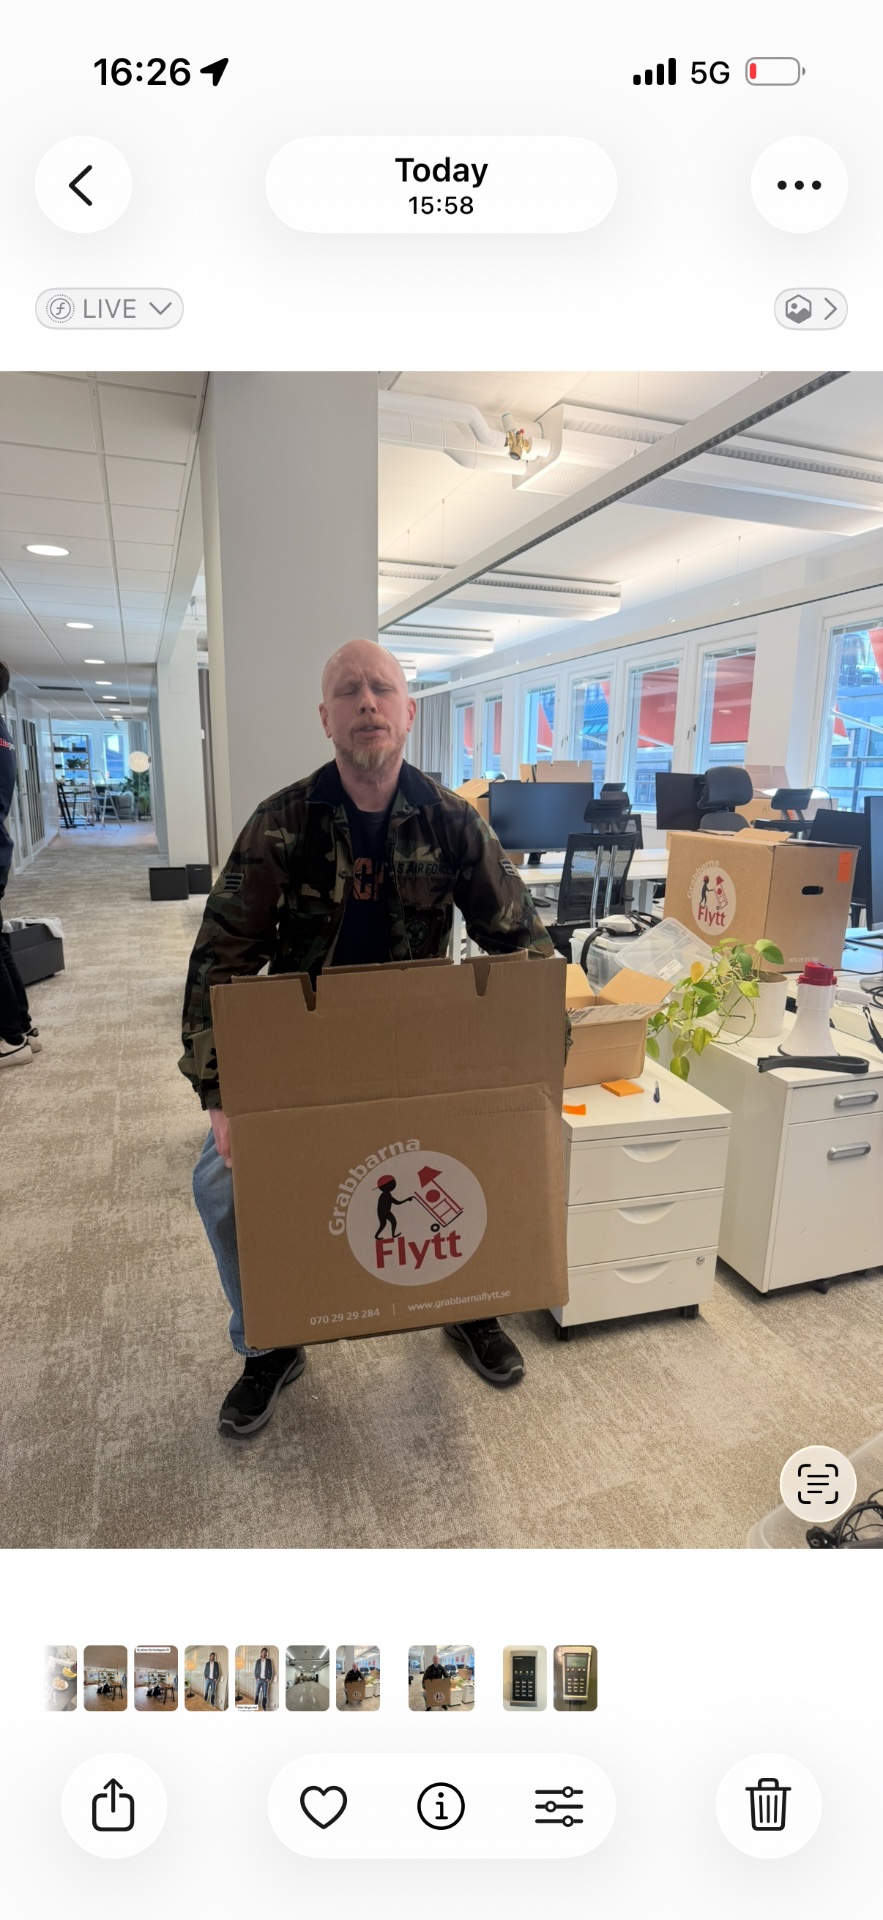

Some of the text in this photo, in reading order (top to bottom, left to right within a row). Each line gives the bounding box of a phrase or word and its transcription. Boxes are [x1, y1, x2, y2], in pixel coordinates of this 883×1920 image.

[406, 861, 424, 874] AIR
[687, 859, 720, 899] Grabbarna
[697, 903, 726, 927] Flytt
[328, 1138, 421, 1236] Grabbarna
[374, 1229, 463, 1270] Flytt
[309, 1288, 512, 1326] 070 29 29 284 www.grabbarnaflytt.se
